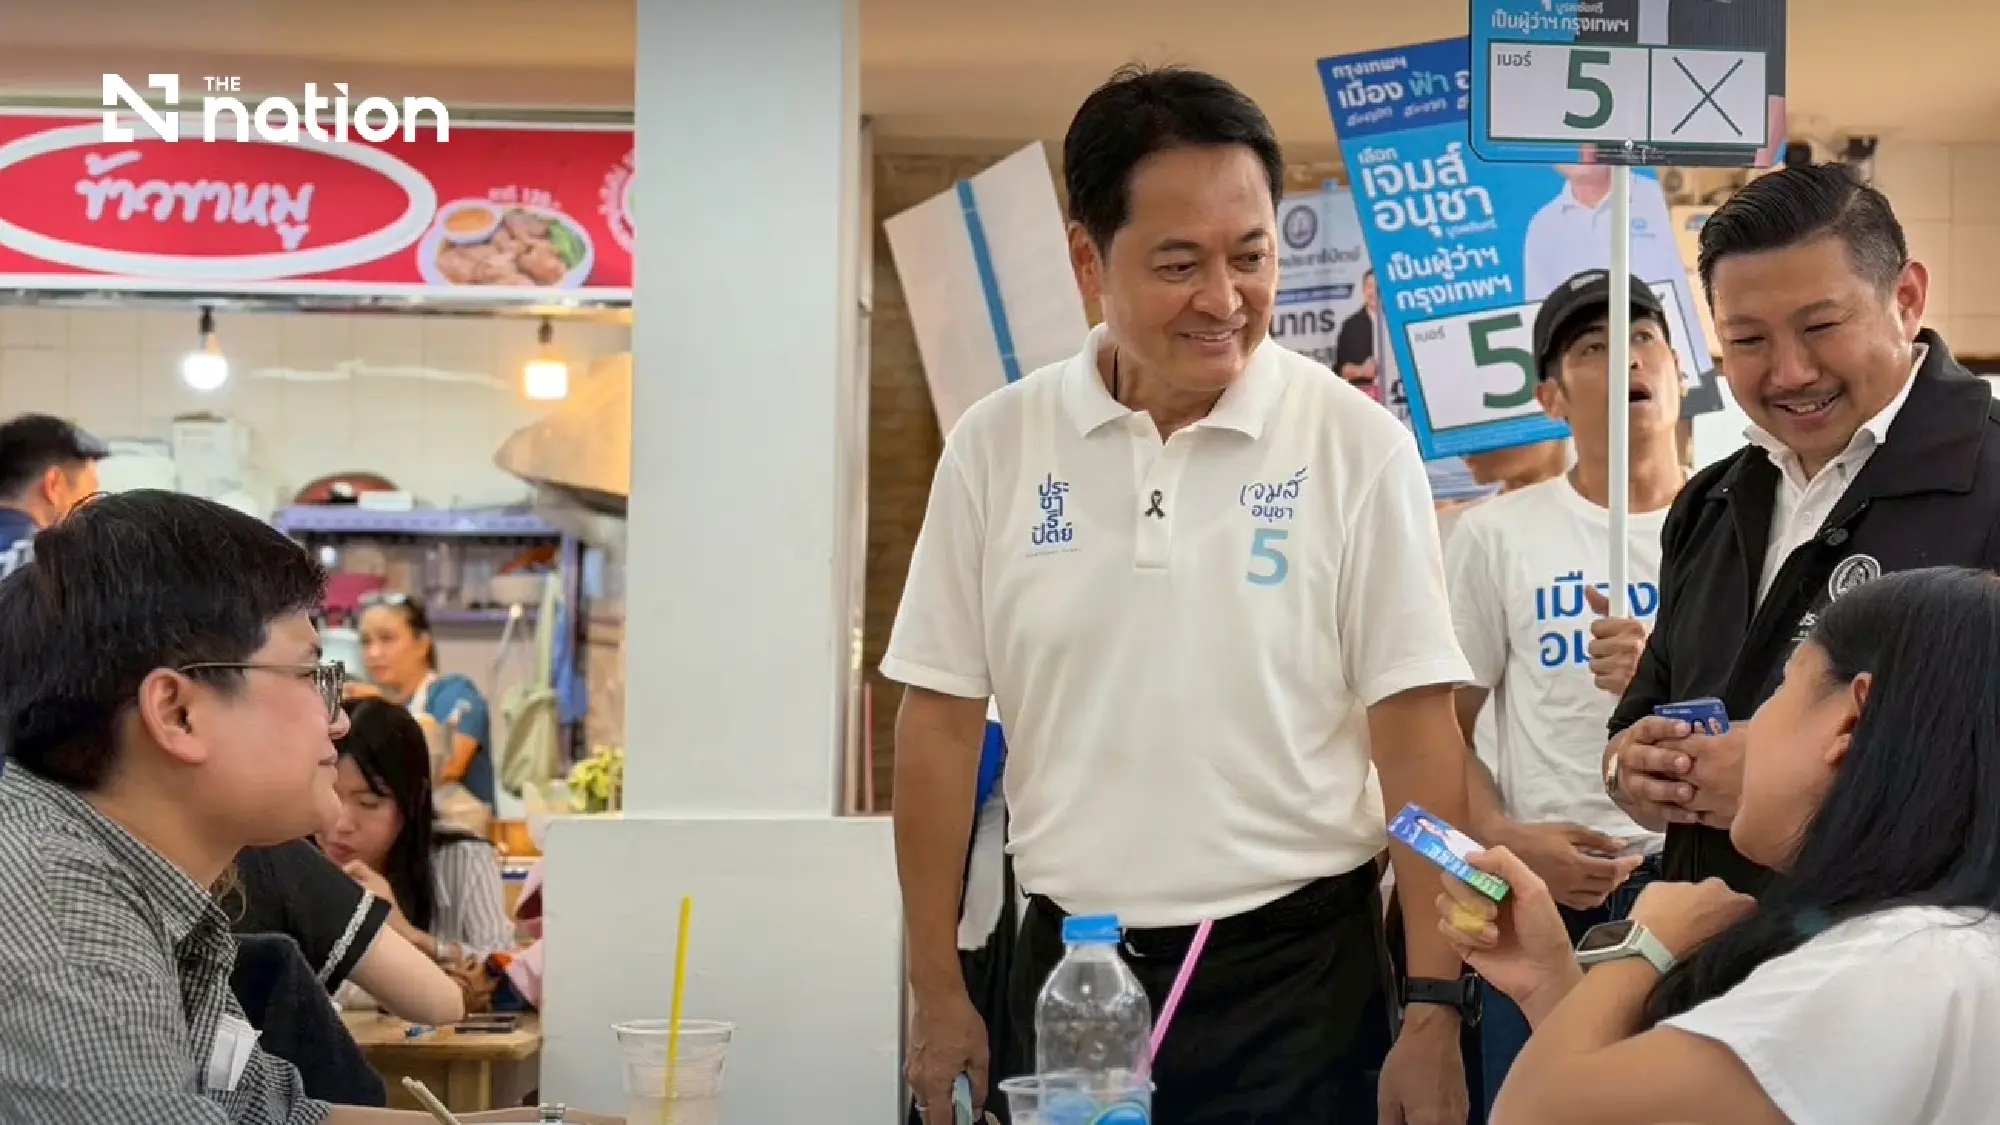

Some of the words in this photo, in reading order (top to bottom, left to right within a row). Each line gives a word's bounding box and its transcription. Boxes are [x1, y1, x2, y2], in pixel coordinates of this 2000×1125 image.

[1561, 17, 1629, 35] กรุงเทพฯ
[1497, 50, 1532, 67] เบอร์
[1337, 79, 1404, 109] เมือง
[1563, 49, 1613, 129] 5
[1362, 142, 1468, 198] เจมส์
[75, 150, 315, 250] ข้าวขาหมู
[1373, 185, 1493, 237] อนุชา
[1387, 243, 1499, 282] เป็นผู้ว่าฯ
[1396, 273, 1513, 313] กรุงเทพฯ
[1468, 313, 1537, 409] 5
[1240, 465, 1309, 506] เจมส์
[1252, 504, 1293, 523] อนุชา
[1245, 528, 1289, 586] 5
[1536, 570, 1658, 621] เมืง
